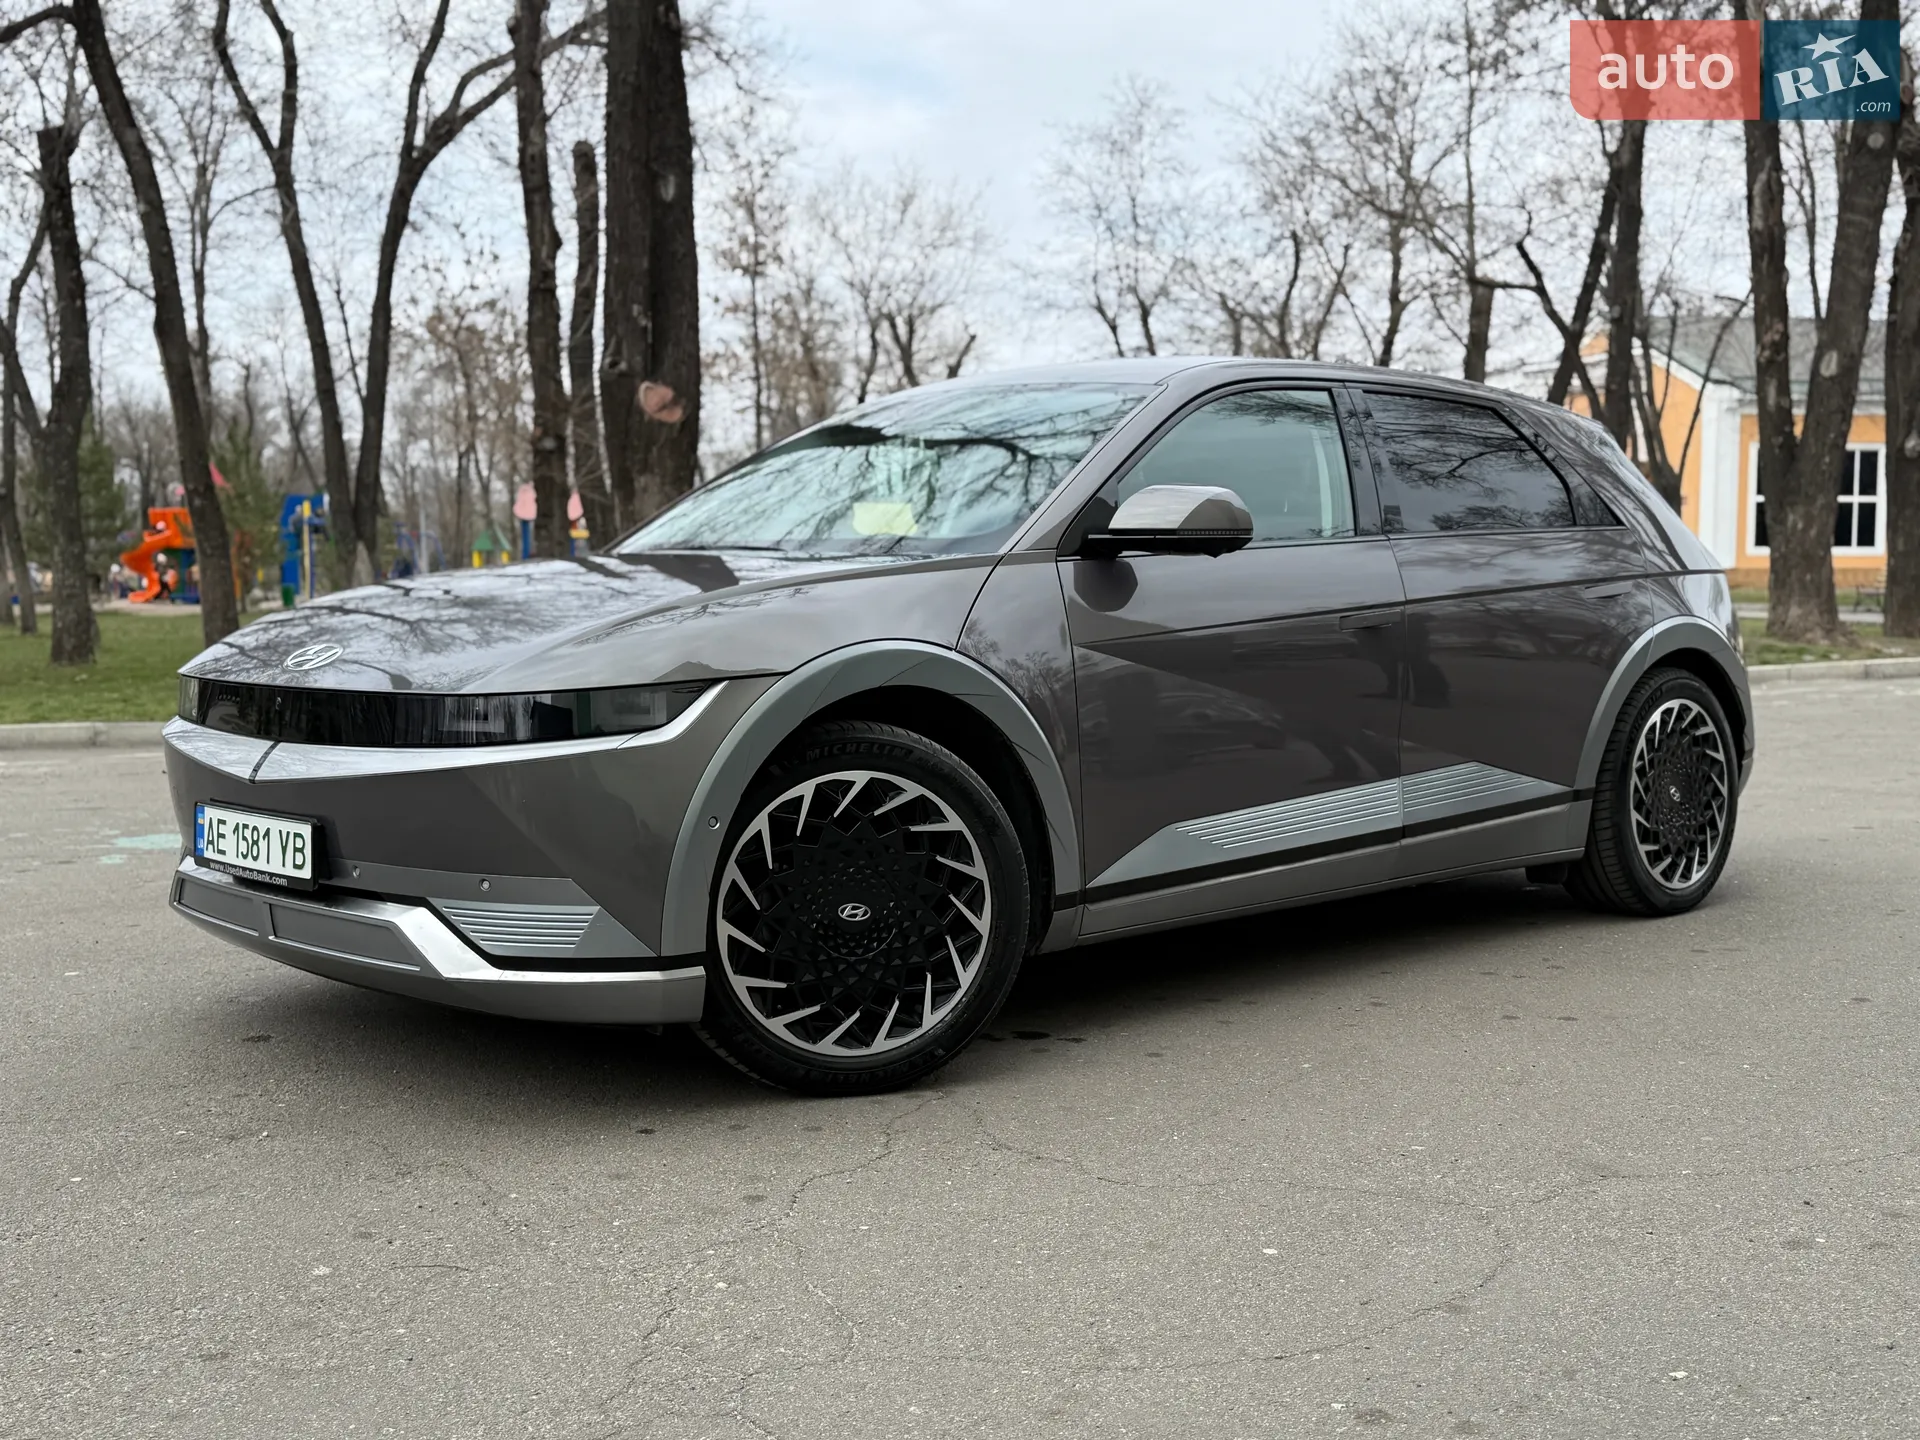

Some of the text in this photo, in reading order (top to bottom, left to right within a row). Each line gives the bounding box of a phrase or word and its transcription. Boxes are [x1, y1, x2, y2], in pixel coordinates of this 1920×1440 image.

[205, 816, 306, 870] AE 1581 YB
[209, 861, 288, 886] www.UsedAutoBank.com
